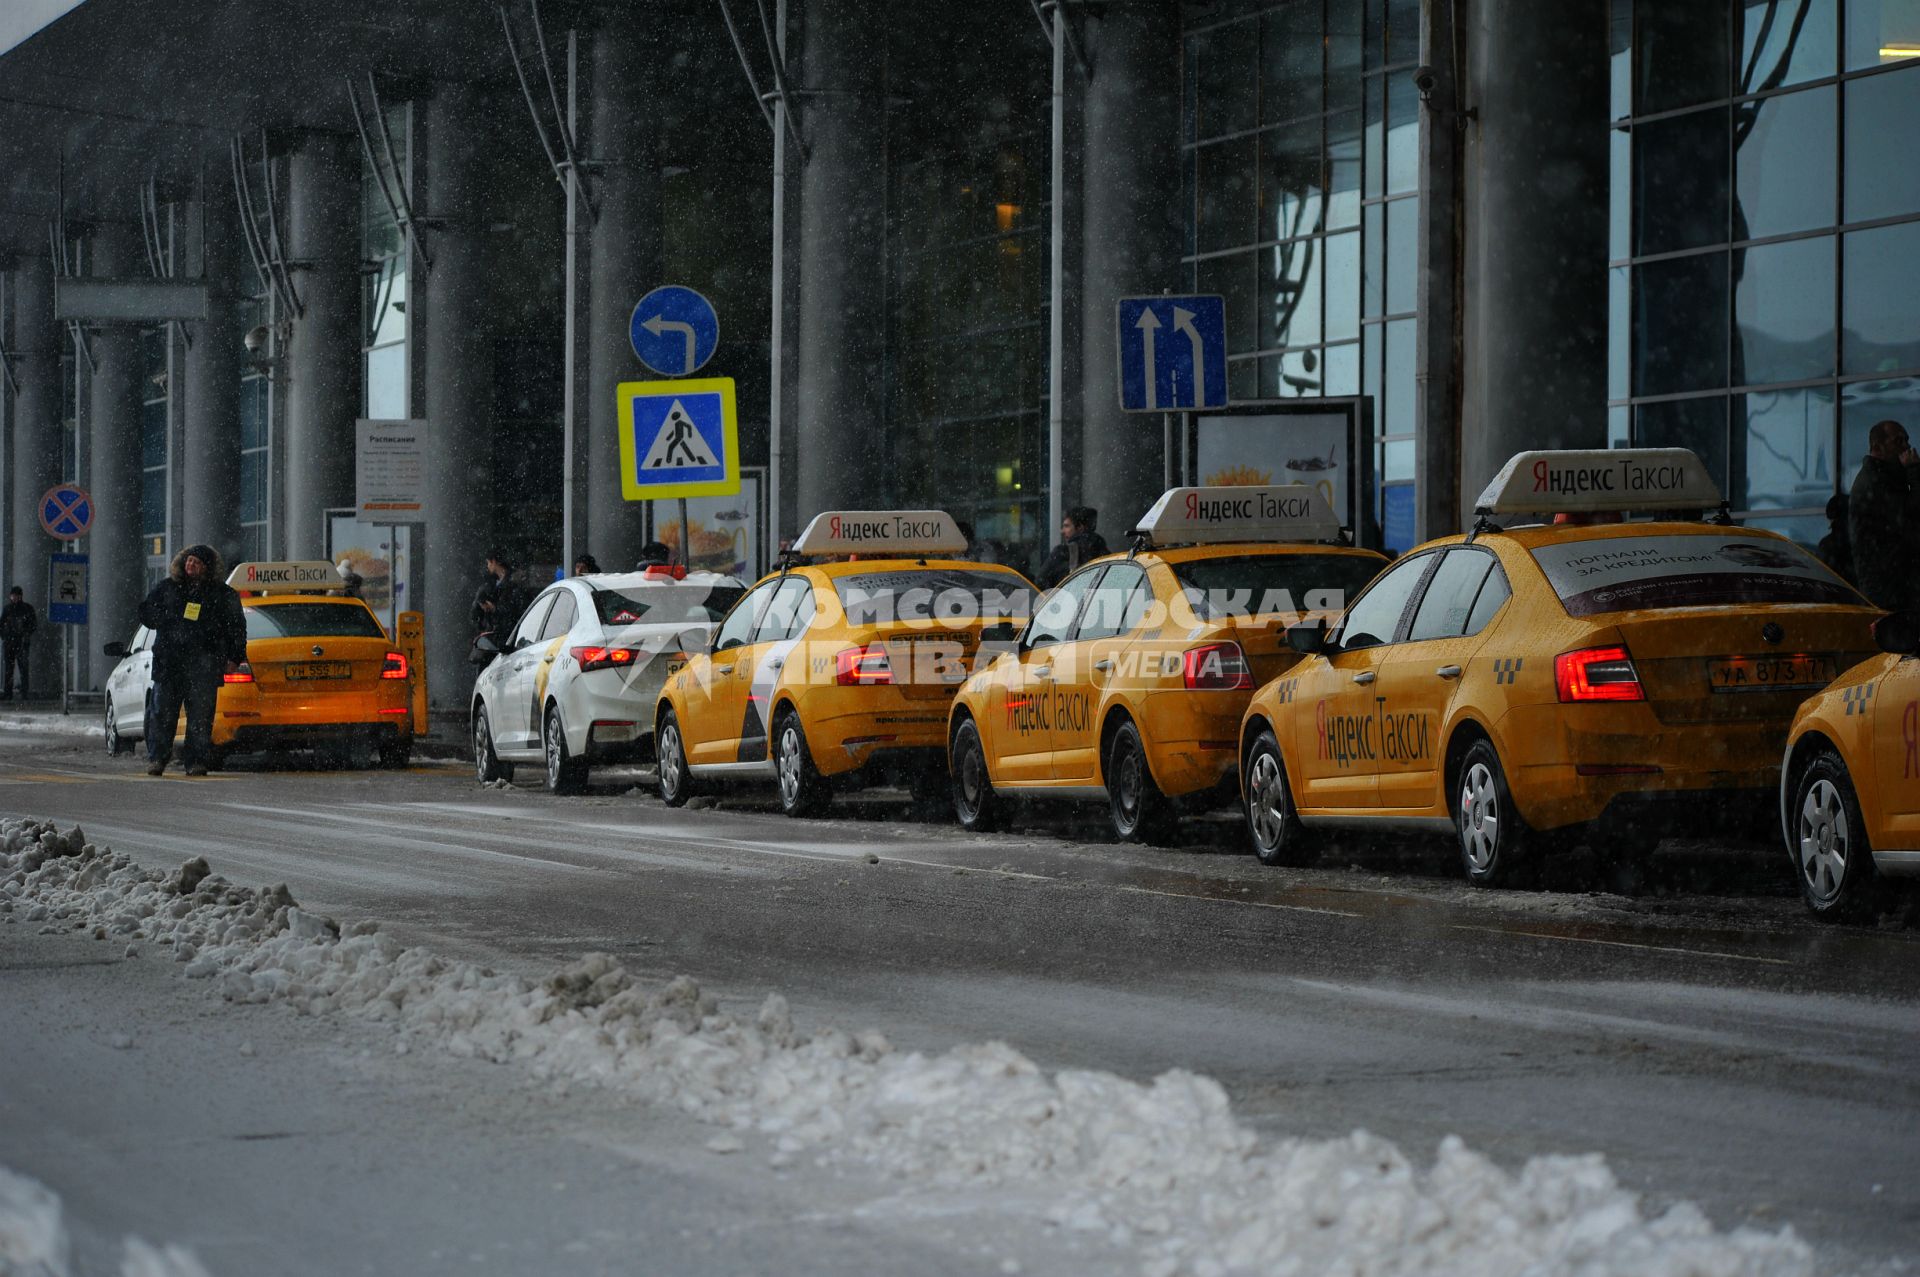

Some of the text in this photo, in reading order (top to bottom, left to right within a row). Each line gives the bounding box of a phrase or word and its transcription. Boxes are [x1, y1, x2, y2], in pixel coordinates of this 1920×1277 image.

[369, 435, 416, 444] Расписание
[1533, 460, 1684, 495] Яндекс Такси
[1185, 493, 1310, 522] Яндекс Такси
[830, 516, 941, 541] Яндекс Такси
[1566, 549, 1659, 567] ПОГНАЛИ
[1576, 555, 1713, 577] ЗА КРЕДИТОМ!
[247, 565, 327, 583] Яндекс Такси
[1720, 667, 1748, 683] УА
[1756, 661, 1796, 682] 873
[1006, 678, 1091, 737] Яндекс Такси
[1316, 697, 1430, 768] Яндекс Такси
